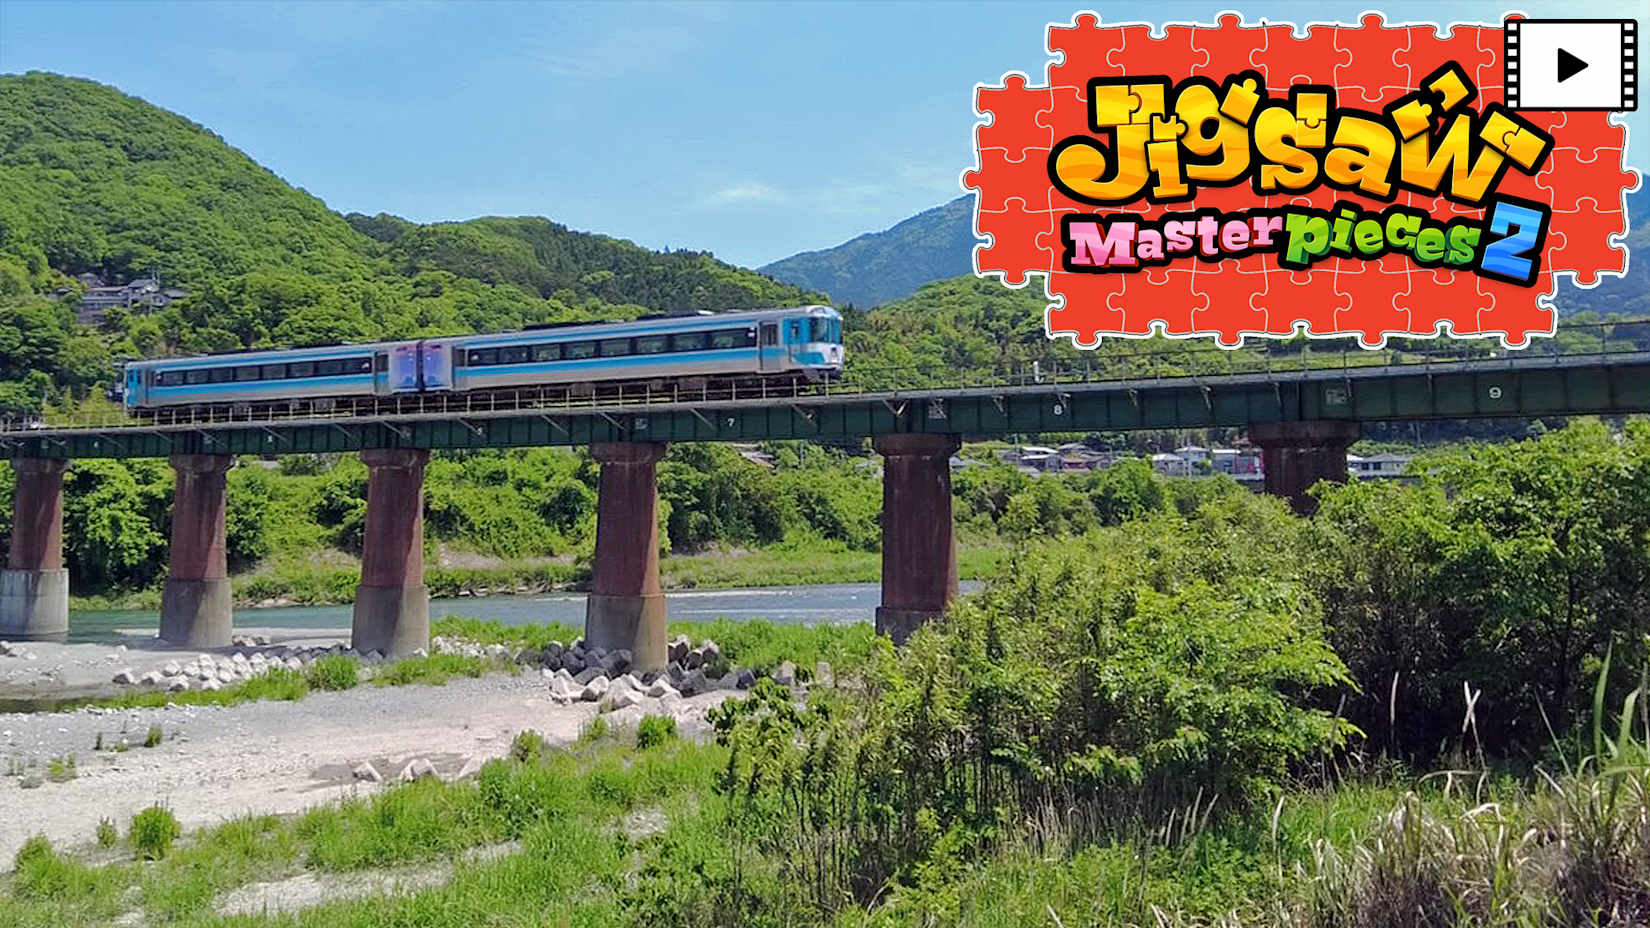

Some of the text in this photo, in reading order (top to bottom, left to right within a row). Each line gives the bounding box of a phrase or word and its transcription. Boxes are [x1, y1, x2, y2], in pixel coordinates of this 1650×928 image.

[1489, 386, 1502, 399] 9
[1054, 404, 1063, 415] 8
[727, 417, 735, 427] 7
